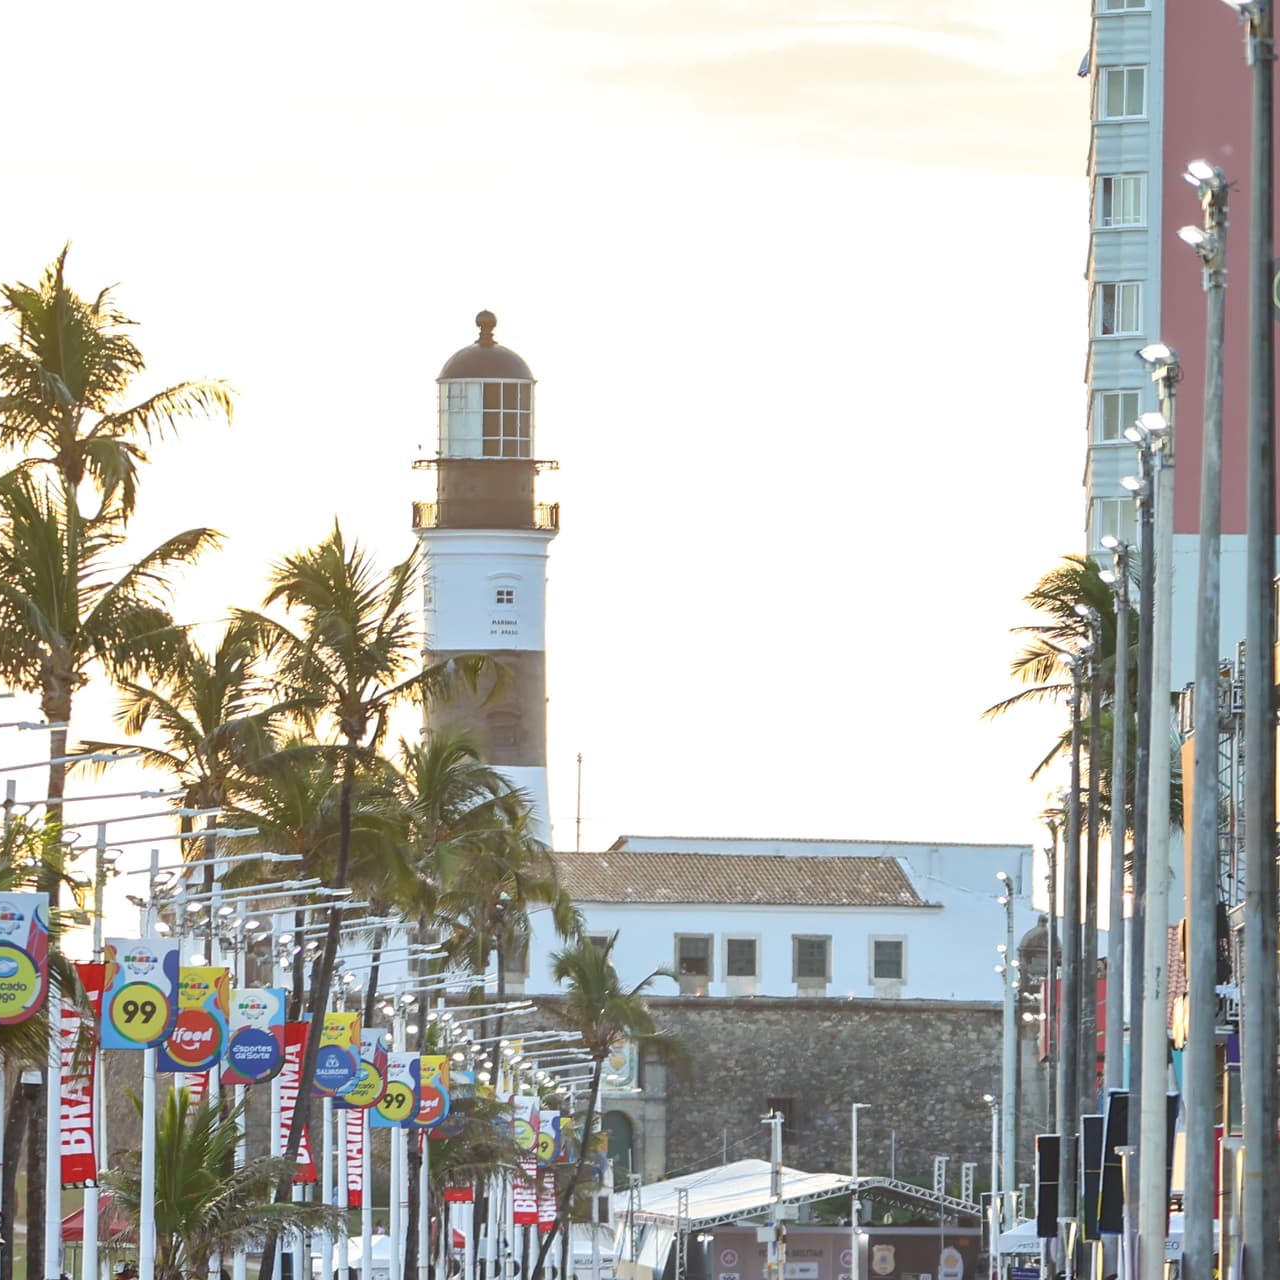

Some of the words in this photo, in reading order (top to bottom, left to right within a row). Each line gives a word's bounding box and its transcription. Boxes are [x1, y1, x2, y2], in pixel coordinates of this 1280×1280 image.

[122, 1000, 157, 1024] 99
[172, 1027, 213, 1043] ifood
[383, 1093, 406, 1109] 99
[540, 1141, 550, 1153] 9
